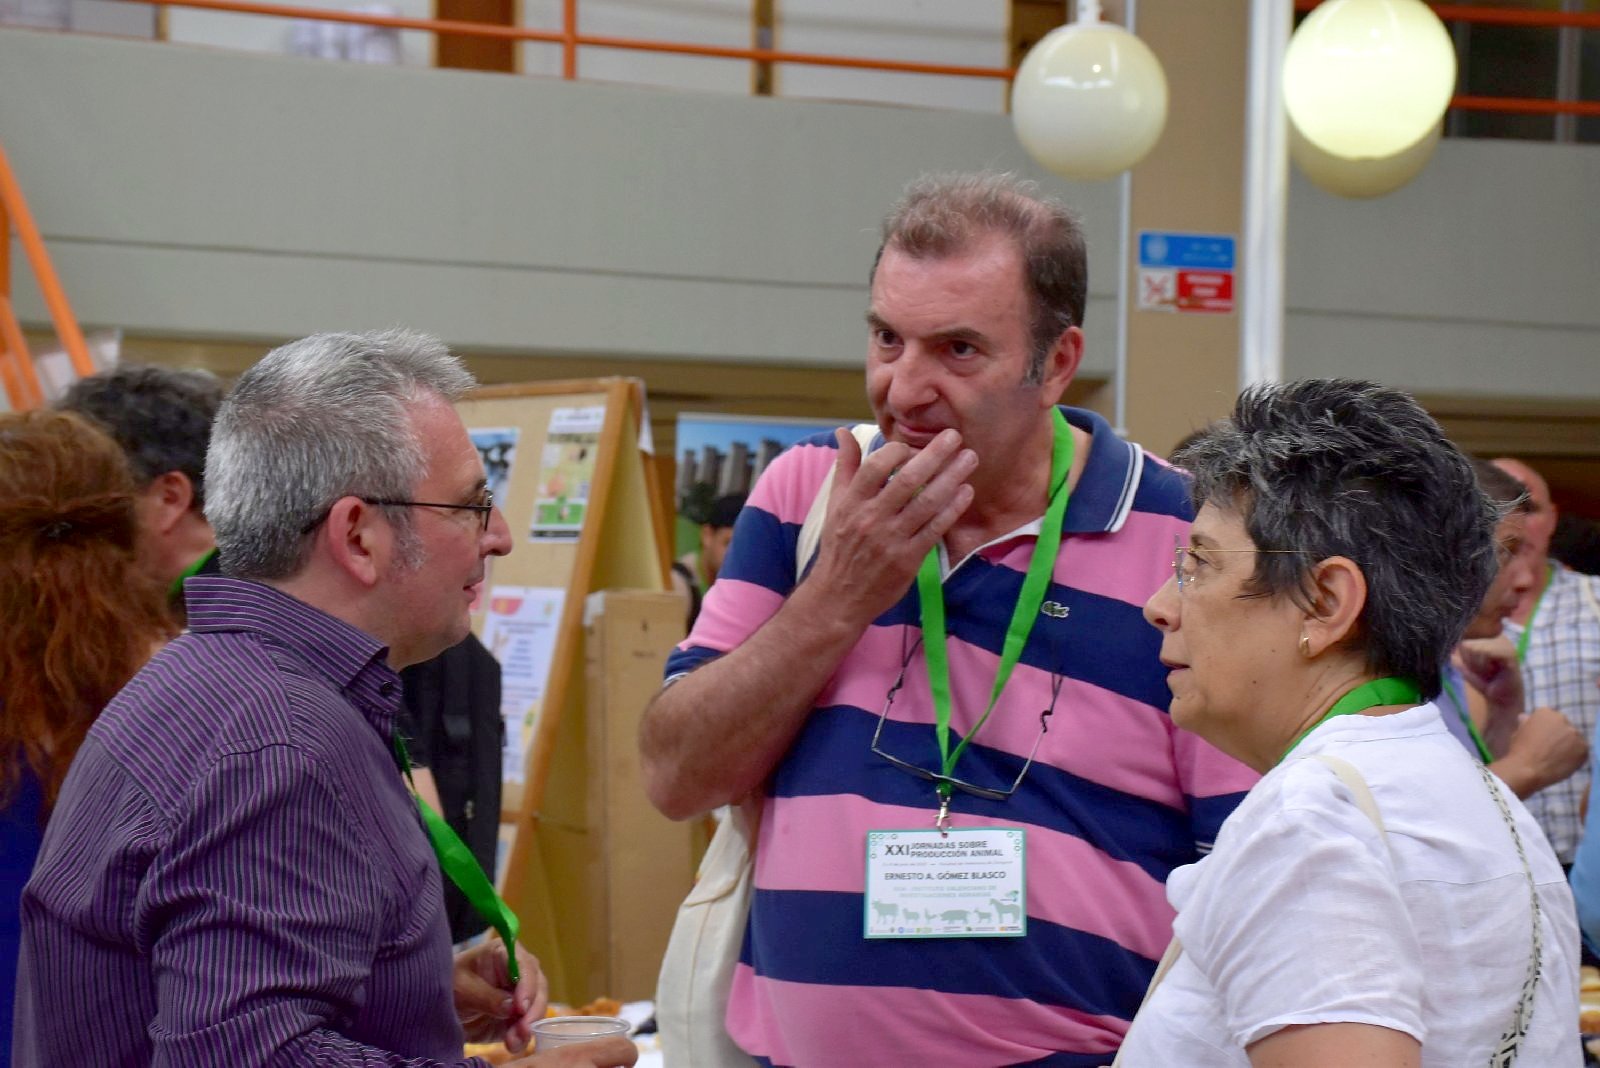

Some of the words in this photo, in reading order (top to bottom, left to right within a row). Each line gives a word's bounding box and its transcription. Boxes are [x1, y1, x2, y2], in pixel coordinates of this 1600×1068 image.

[884, 844, 910, 856] XXI
[910, 841, 956, 849] JORNADAS
[958, 840, 988, 848] SOBRE
[910, 849, 967, 858] PRODUCCIÓN
[970, 849, 1004, 857] ANIMAL
[884, 872, 923, 880] ERNESTO
[936, 870, 969, 880] GÓMEZ
[971, 871, 1006, 879] BLASCO
